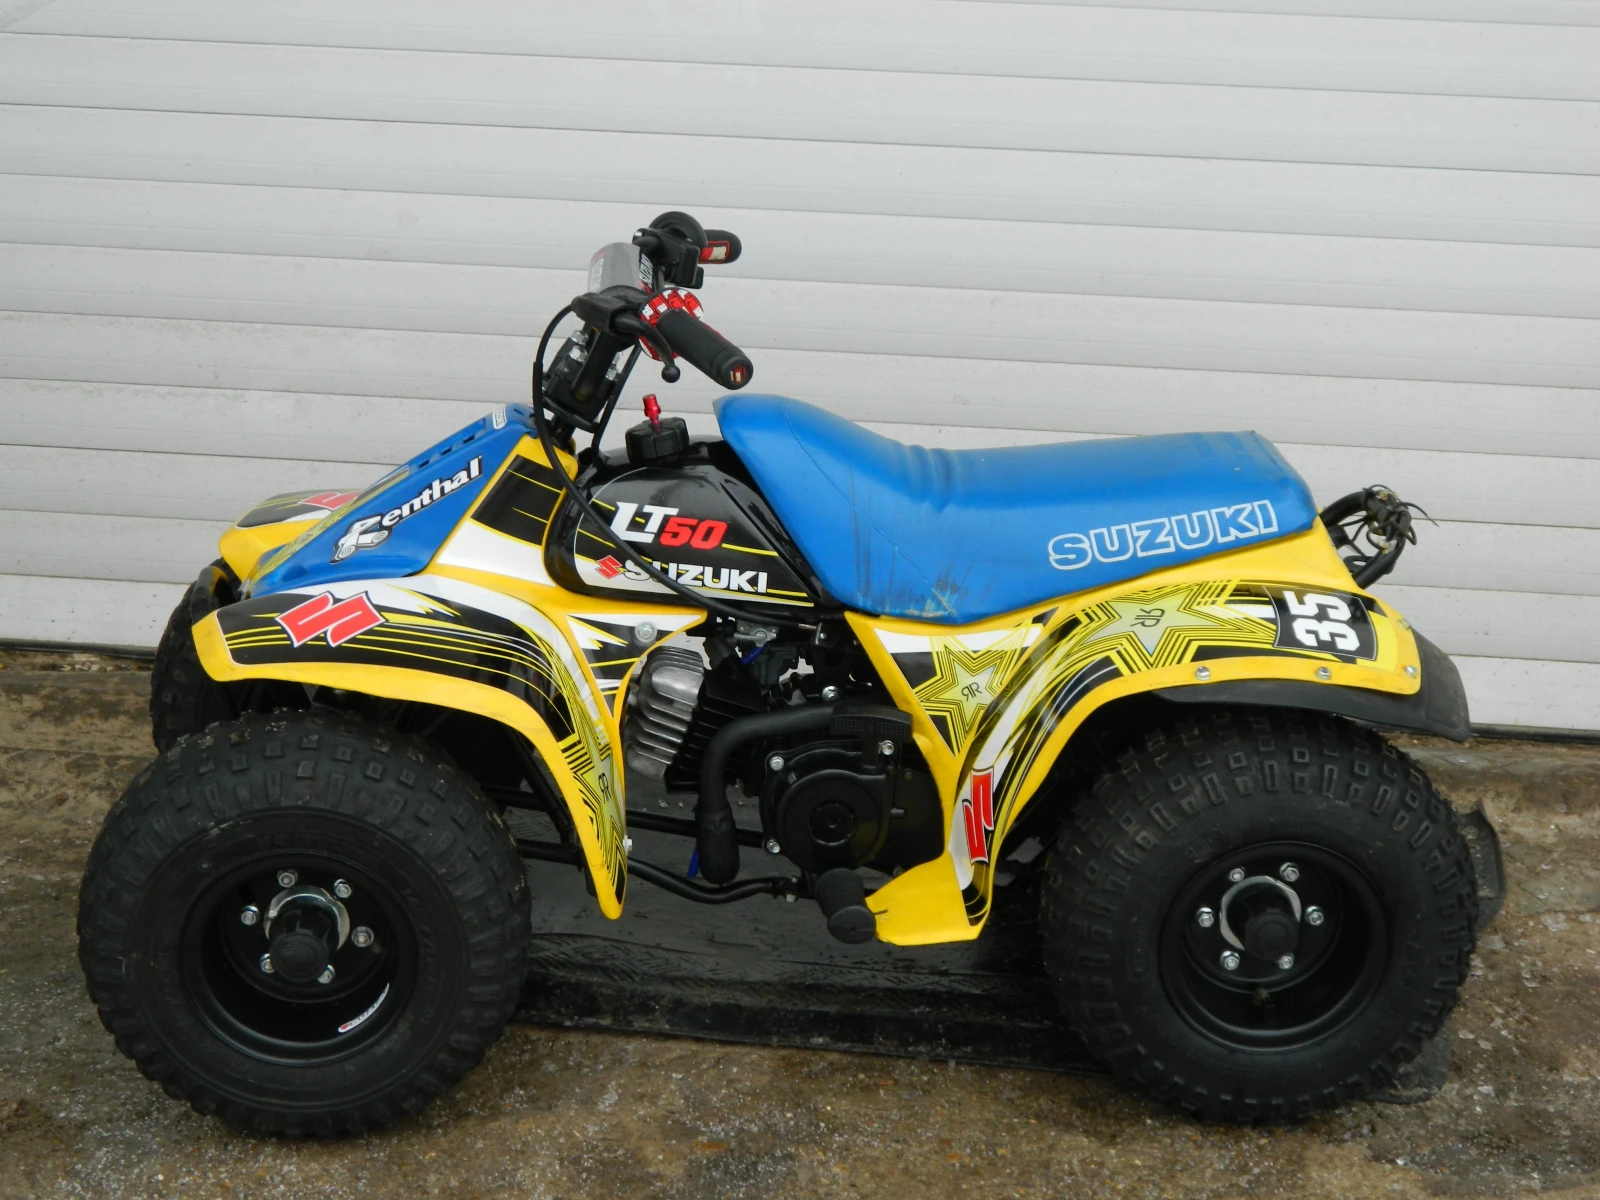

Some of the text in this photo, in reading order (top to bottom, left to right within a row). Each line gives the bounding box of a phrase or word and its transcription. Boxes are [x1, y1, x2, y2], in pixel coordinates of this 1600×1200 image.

[330, 455, 483, 564] Renthal
[610, 501, 728, 550] LT50
[1048, 500, 1279, 571] SUZUKI
[1283, 590, 1361, 651] 35
